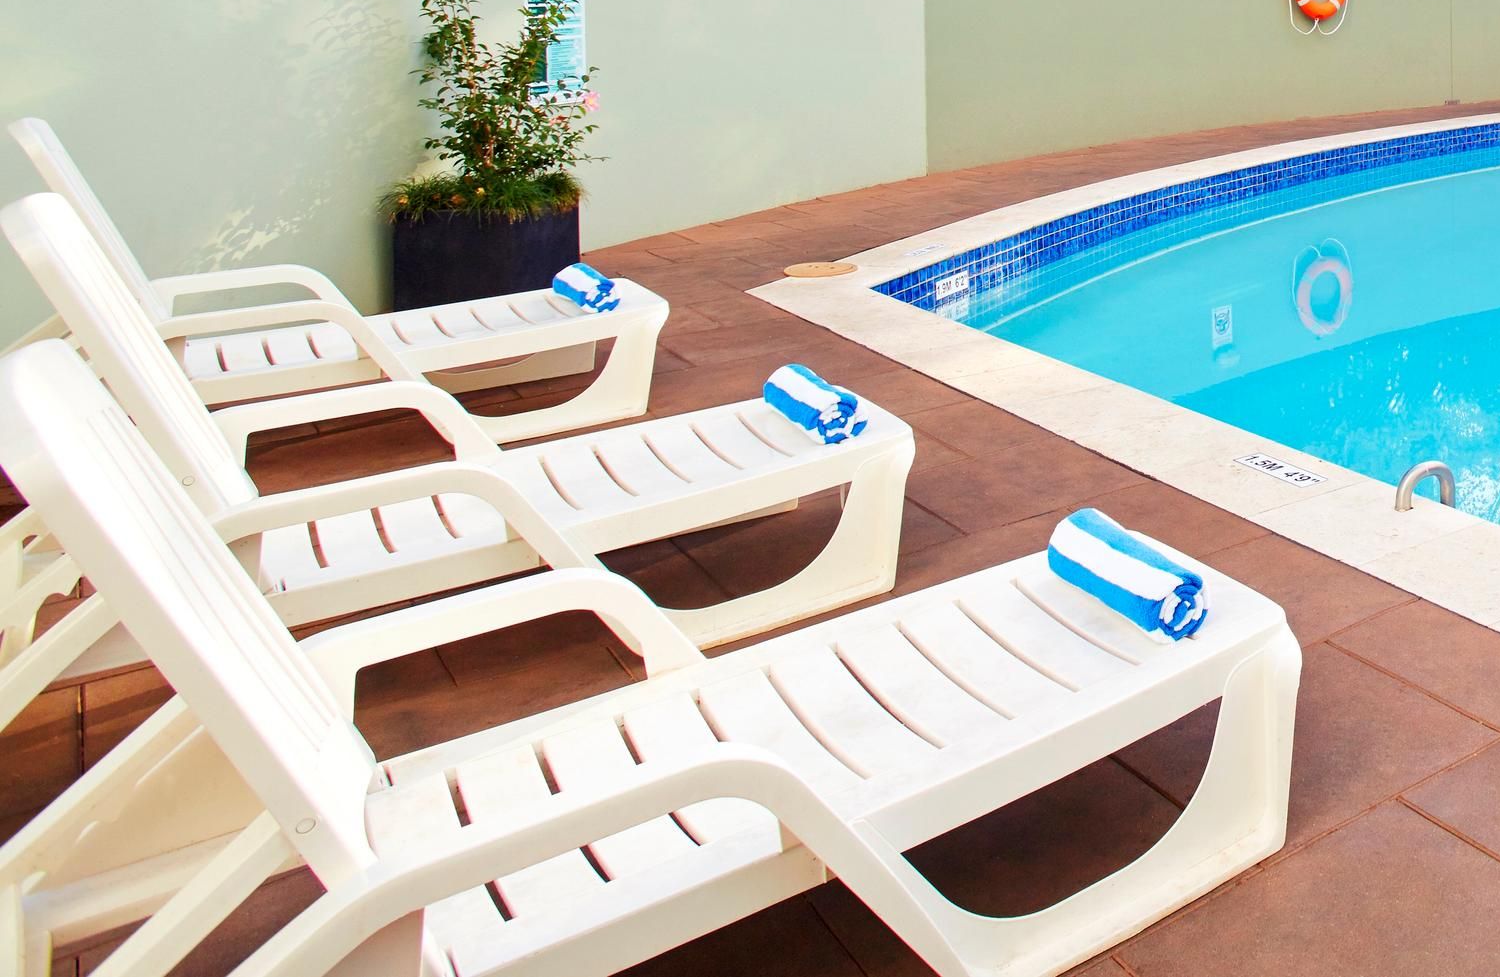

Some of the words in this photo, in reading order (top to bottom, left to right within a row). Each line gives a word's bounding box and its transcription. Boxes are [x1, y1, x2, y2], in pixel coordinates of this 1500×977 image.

[936, 280, 952, 295] 1.9M
[1244, 455, 1284, 472] 1.5M
[1284, 471, 1321, 483] 4'9"
